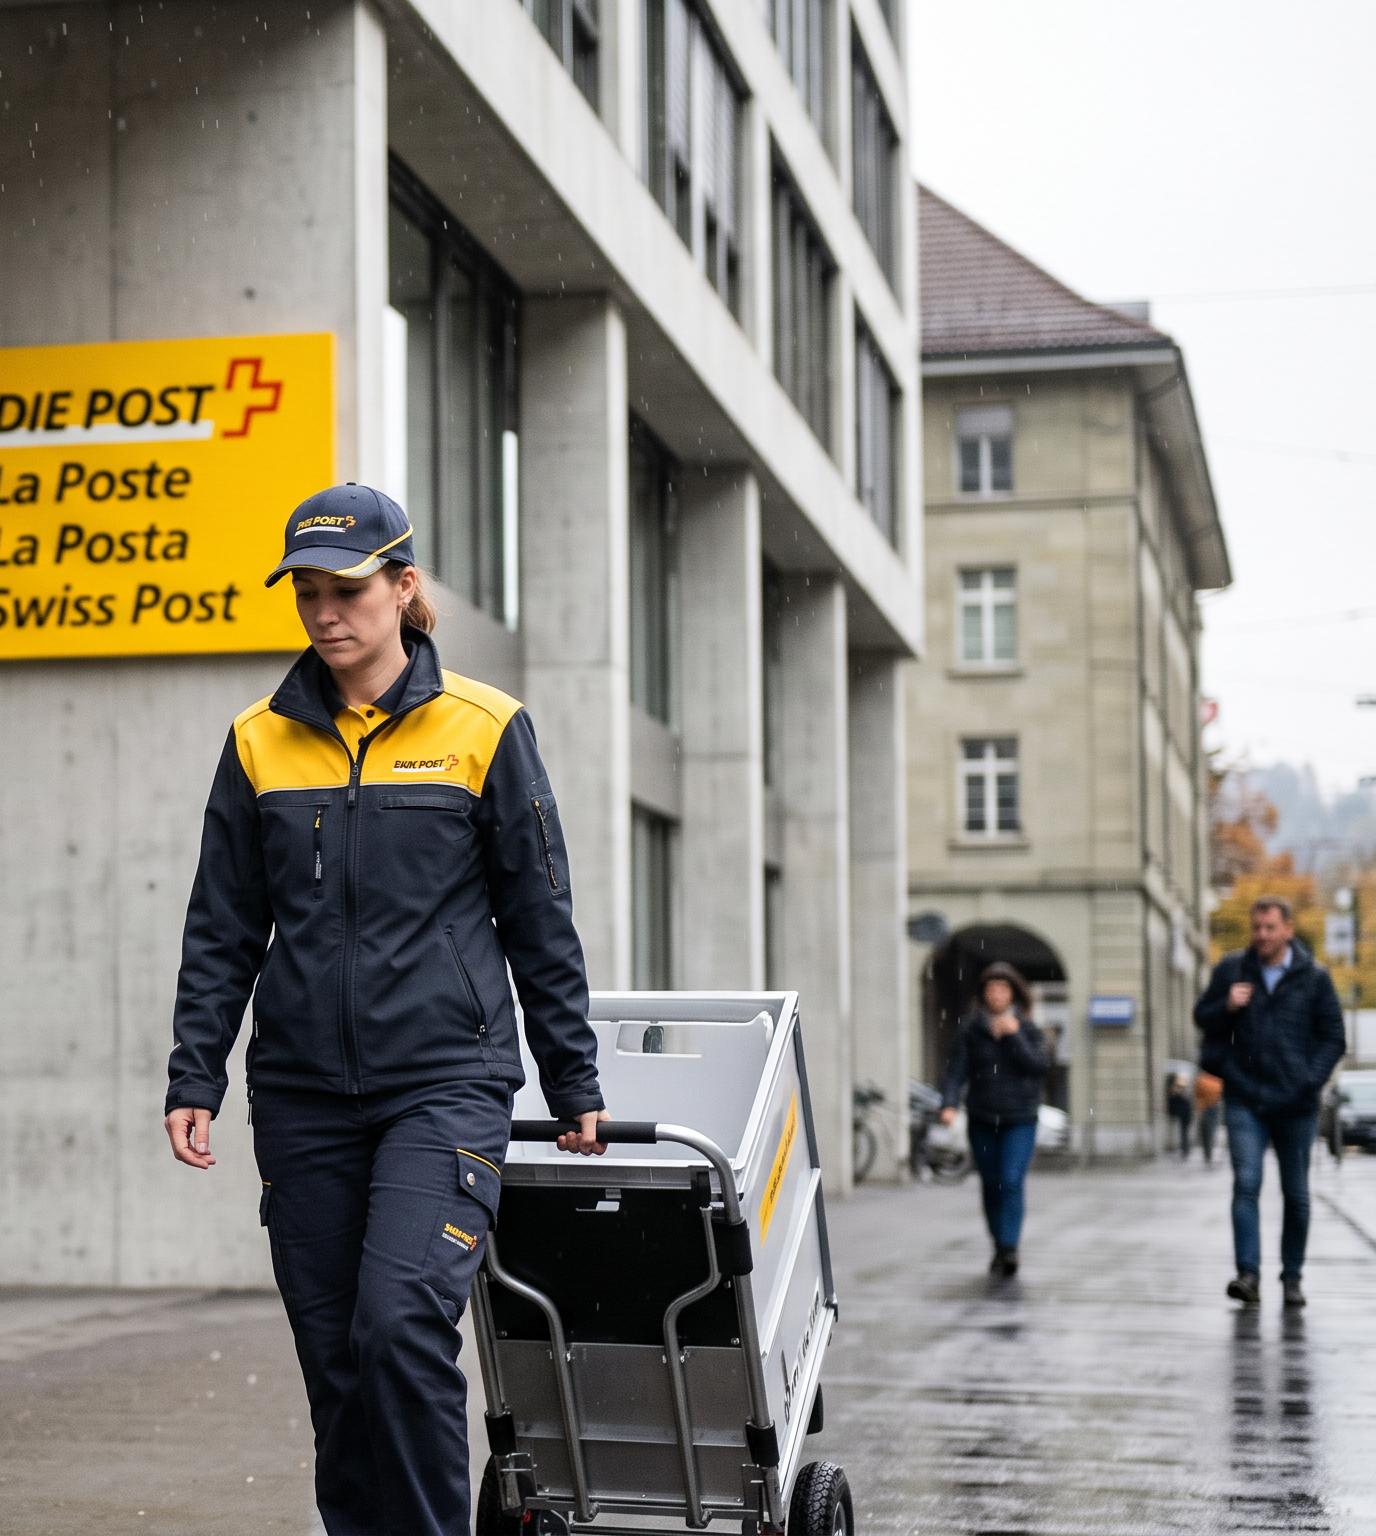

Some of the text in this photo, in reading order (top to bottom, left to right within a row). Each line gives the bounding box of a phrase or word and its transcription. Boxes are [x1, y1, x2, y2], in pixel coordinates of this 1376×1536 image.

[84, 384, 215, 429] POST
[55, 460, 192, 503] Poste
[54, 522, 190, 564] Posta
[131, 582, 240, 625] Post
